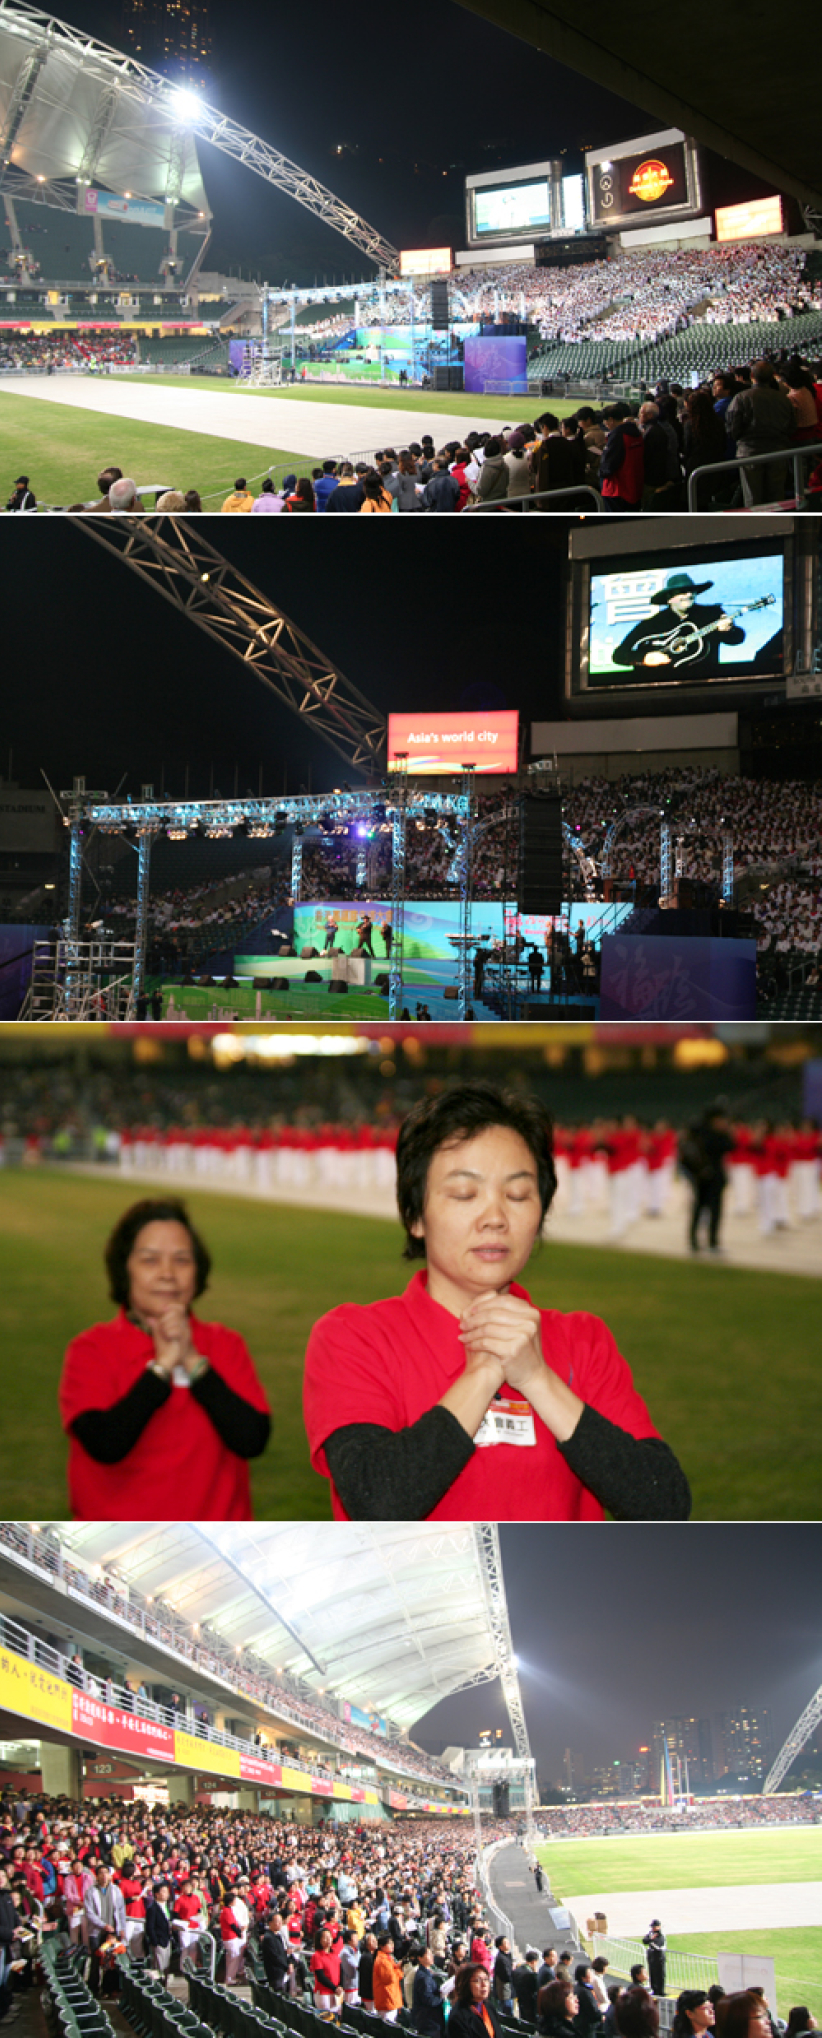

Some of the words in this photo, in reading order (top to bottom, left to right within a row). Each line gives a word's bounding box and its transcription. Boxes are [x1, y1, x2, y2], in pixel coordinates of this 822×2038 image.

[407, 732, 439, 743] Asia's
[442, 731, 475, 742] world
[478, 730, 499, 744] city
[94, 1764, 112, 1774] 123
